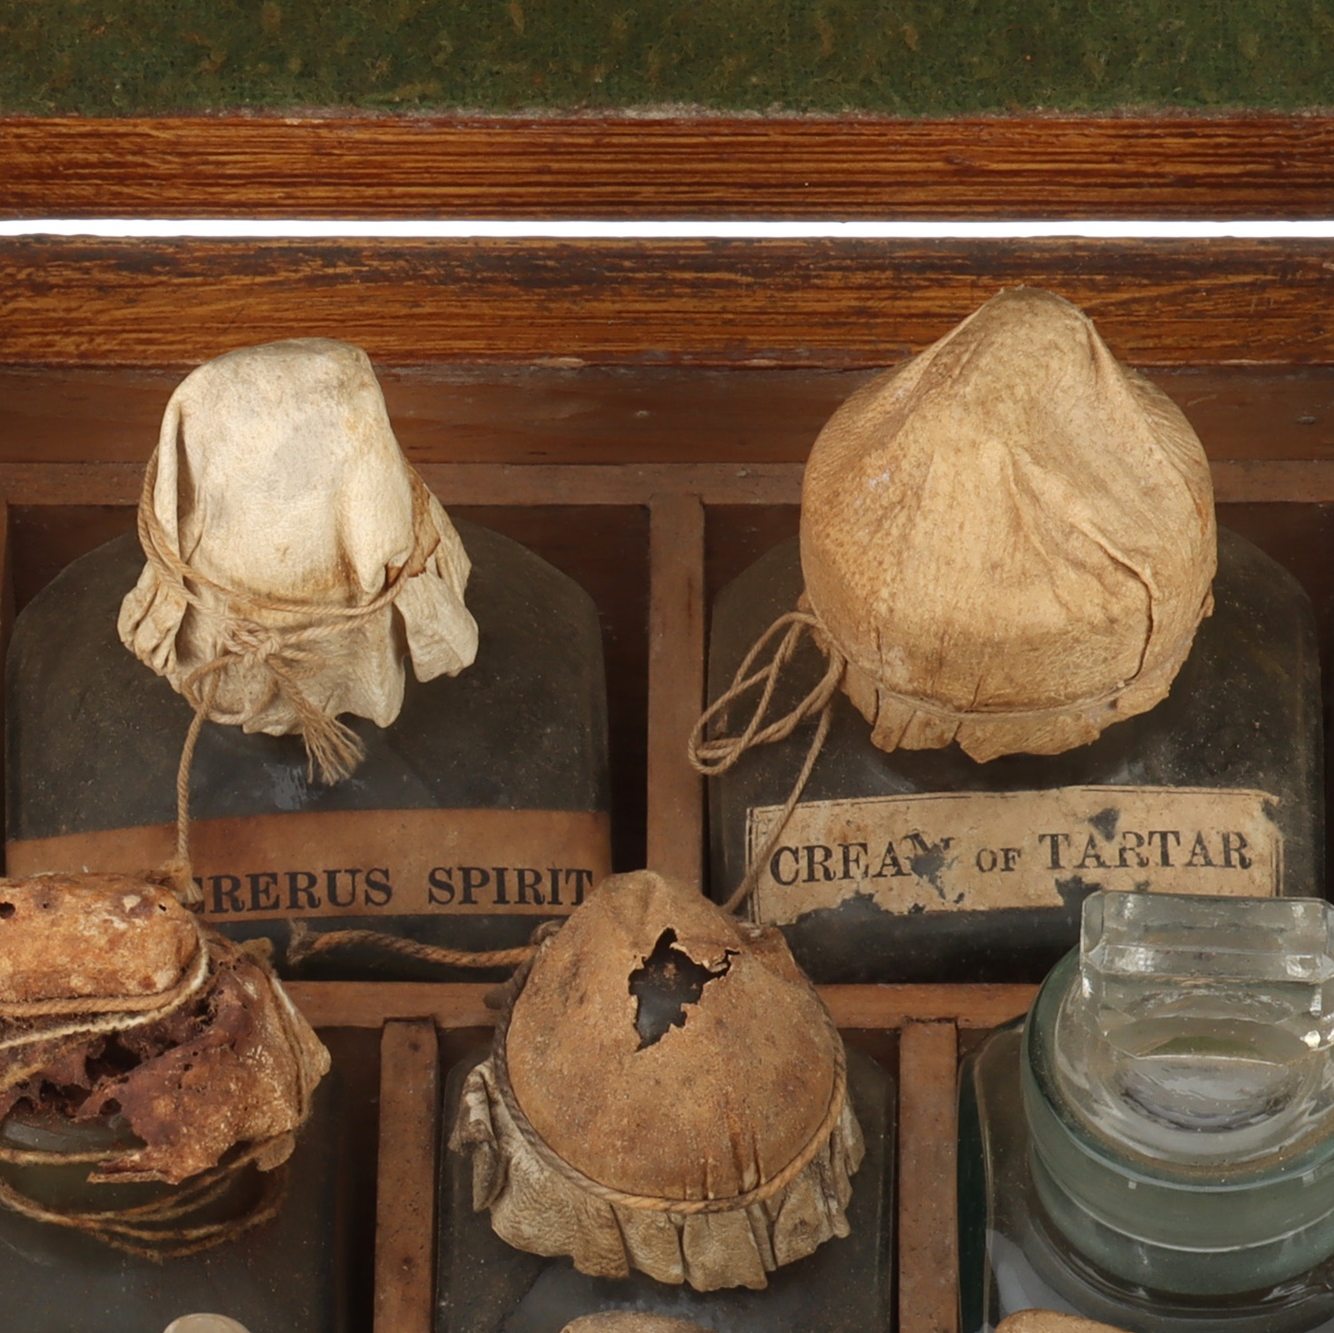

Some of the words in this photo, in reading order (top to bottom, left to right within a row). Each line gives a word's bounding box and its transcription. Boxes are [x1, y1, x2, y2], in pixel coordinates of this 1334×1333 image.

[975, 848, 1022, 874] OF
[1038, 830, 1252, 870] TARTAR
[188, 867, 393, 916] RERUS
[428, 866, 594, 906] SPIRIT
